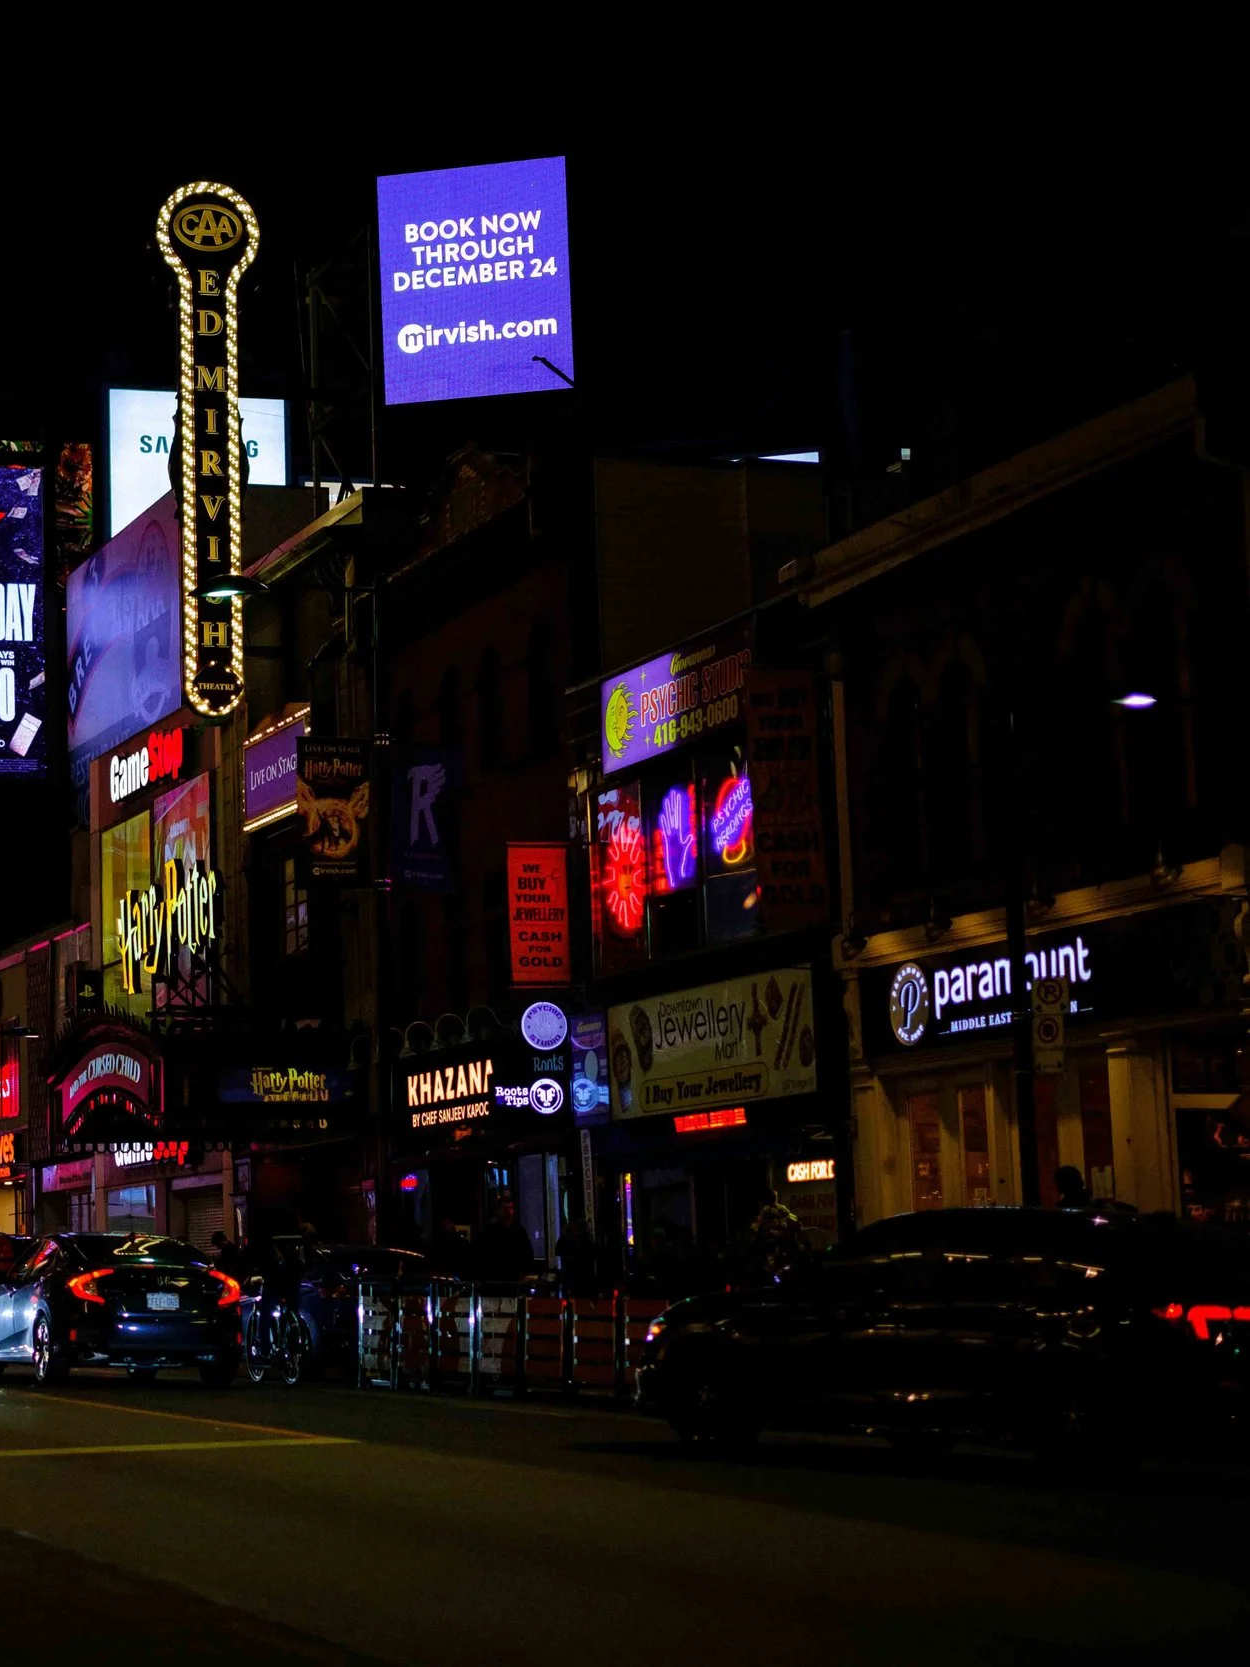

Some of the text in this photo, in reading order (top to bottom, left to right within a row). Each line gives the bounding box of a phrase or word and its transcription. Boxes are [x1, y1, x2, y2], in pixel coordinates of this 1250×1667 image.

[181, 209, 234, 245] CAA
[404, 209, 542, 244] BOOK NOW
[411, 234, 535, 266] THROUGH
[393, 256, 558, 292] DECEMBER 24
[398, 317, 558, 353] mirvish.com
[198, 682, 235, 691] THEATRE
[640, 671, 699, 728] PSYCHIC
[653, 694, 739, 748] 416-943-0600
[109, 727, 183, 803] GameStop
[304, 757, 363, 781] Harry Potter
[250, 771, 266, 791] LIVE
[266, 764, 277, 782] ON
[712, 779, 750, 833] PSYCHIC
[522, 863, 541, 873] WE
[517, 877, 547, 890] BUY
[514, 893, 551, 903] YOUR
[513, 907, 565, 922] JEWELLERY
[116, 858, 217, 995] Harry Potter
[518, 931, 563, 942] CASH
[528, 945, 552, 953] FOR
[519, 956, 563, 968] GOLD
[527, 1004, 563, 1021] PSYCHIC
[659, 996, 704, 1016] Downtown
[655, 999, 747, 1050] Jewellery
[950, 1016, 986, 1033] MIDDLE
[529, 1033, 562, 1048] STUDIO
[87, 1053, 116, 1081] CURSED
[116, 1053, 141, 1083] CHILD
[533, 1055, 565, 1072] Roots
[250, 1071, 288, 1096] Harry
[287, 1067, 327, 1093] Potter
[495, 1086, 529, 1097] Roots
[652, 1083, 674, 1105] Buy
[676, 1081, 704, 1099] Your
[705, 1073, 763, 1097] Jewellery
[505, 1096, 530, 1108] Tips
[412, 1113, 421, 1128] BY
[421, 1110, 438, 1126] CHEF
[438, 1105, 466, 1124] SANJEEV
[787, 1161, 810, 1182] CASH
